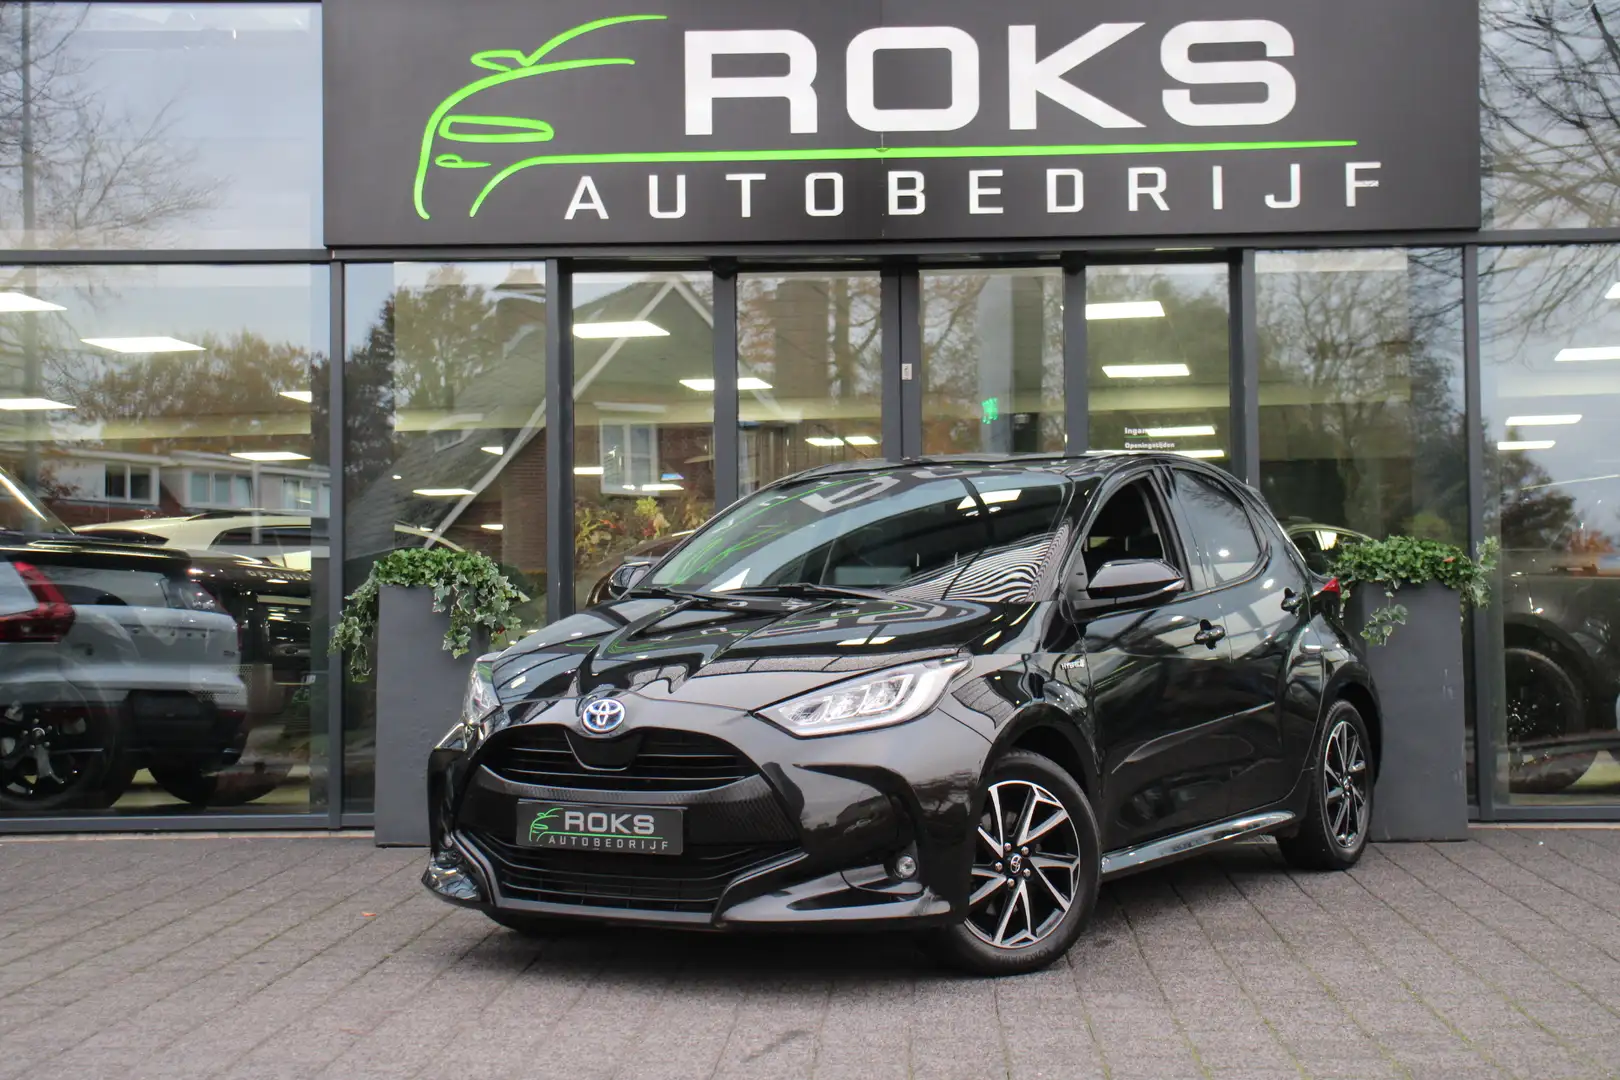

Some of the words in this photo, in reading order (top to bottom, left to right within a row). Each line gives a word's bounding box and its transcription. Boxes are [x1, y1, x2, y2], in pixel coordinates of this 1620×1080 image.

[685, 19, 1297, 135] ROKS
[564, 161, 1382, 220] AUTOBEDRIJF
[548, 835, 669, 850] AUTOBEDRIJF
[564, 811, 655, 835] ROKS
